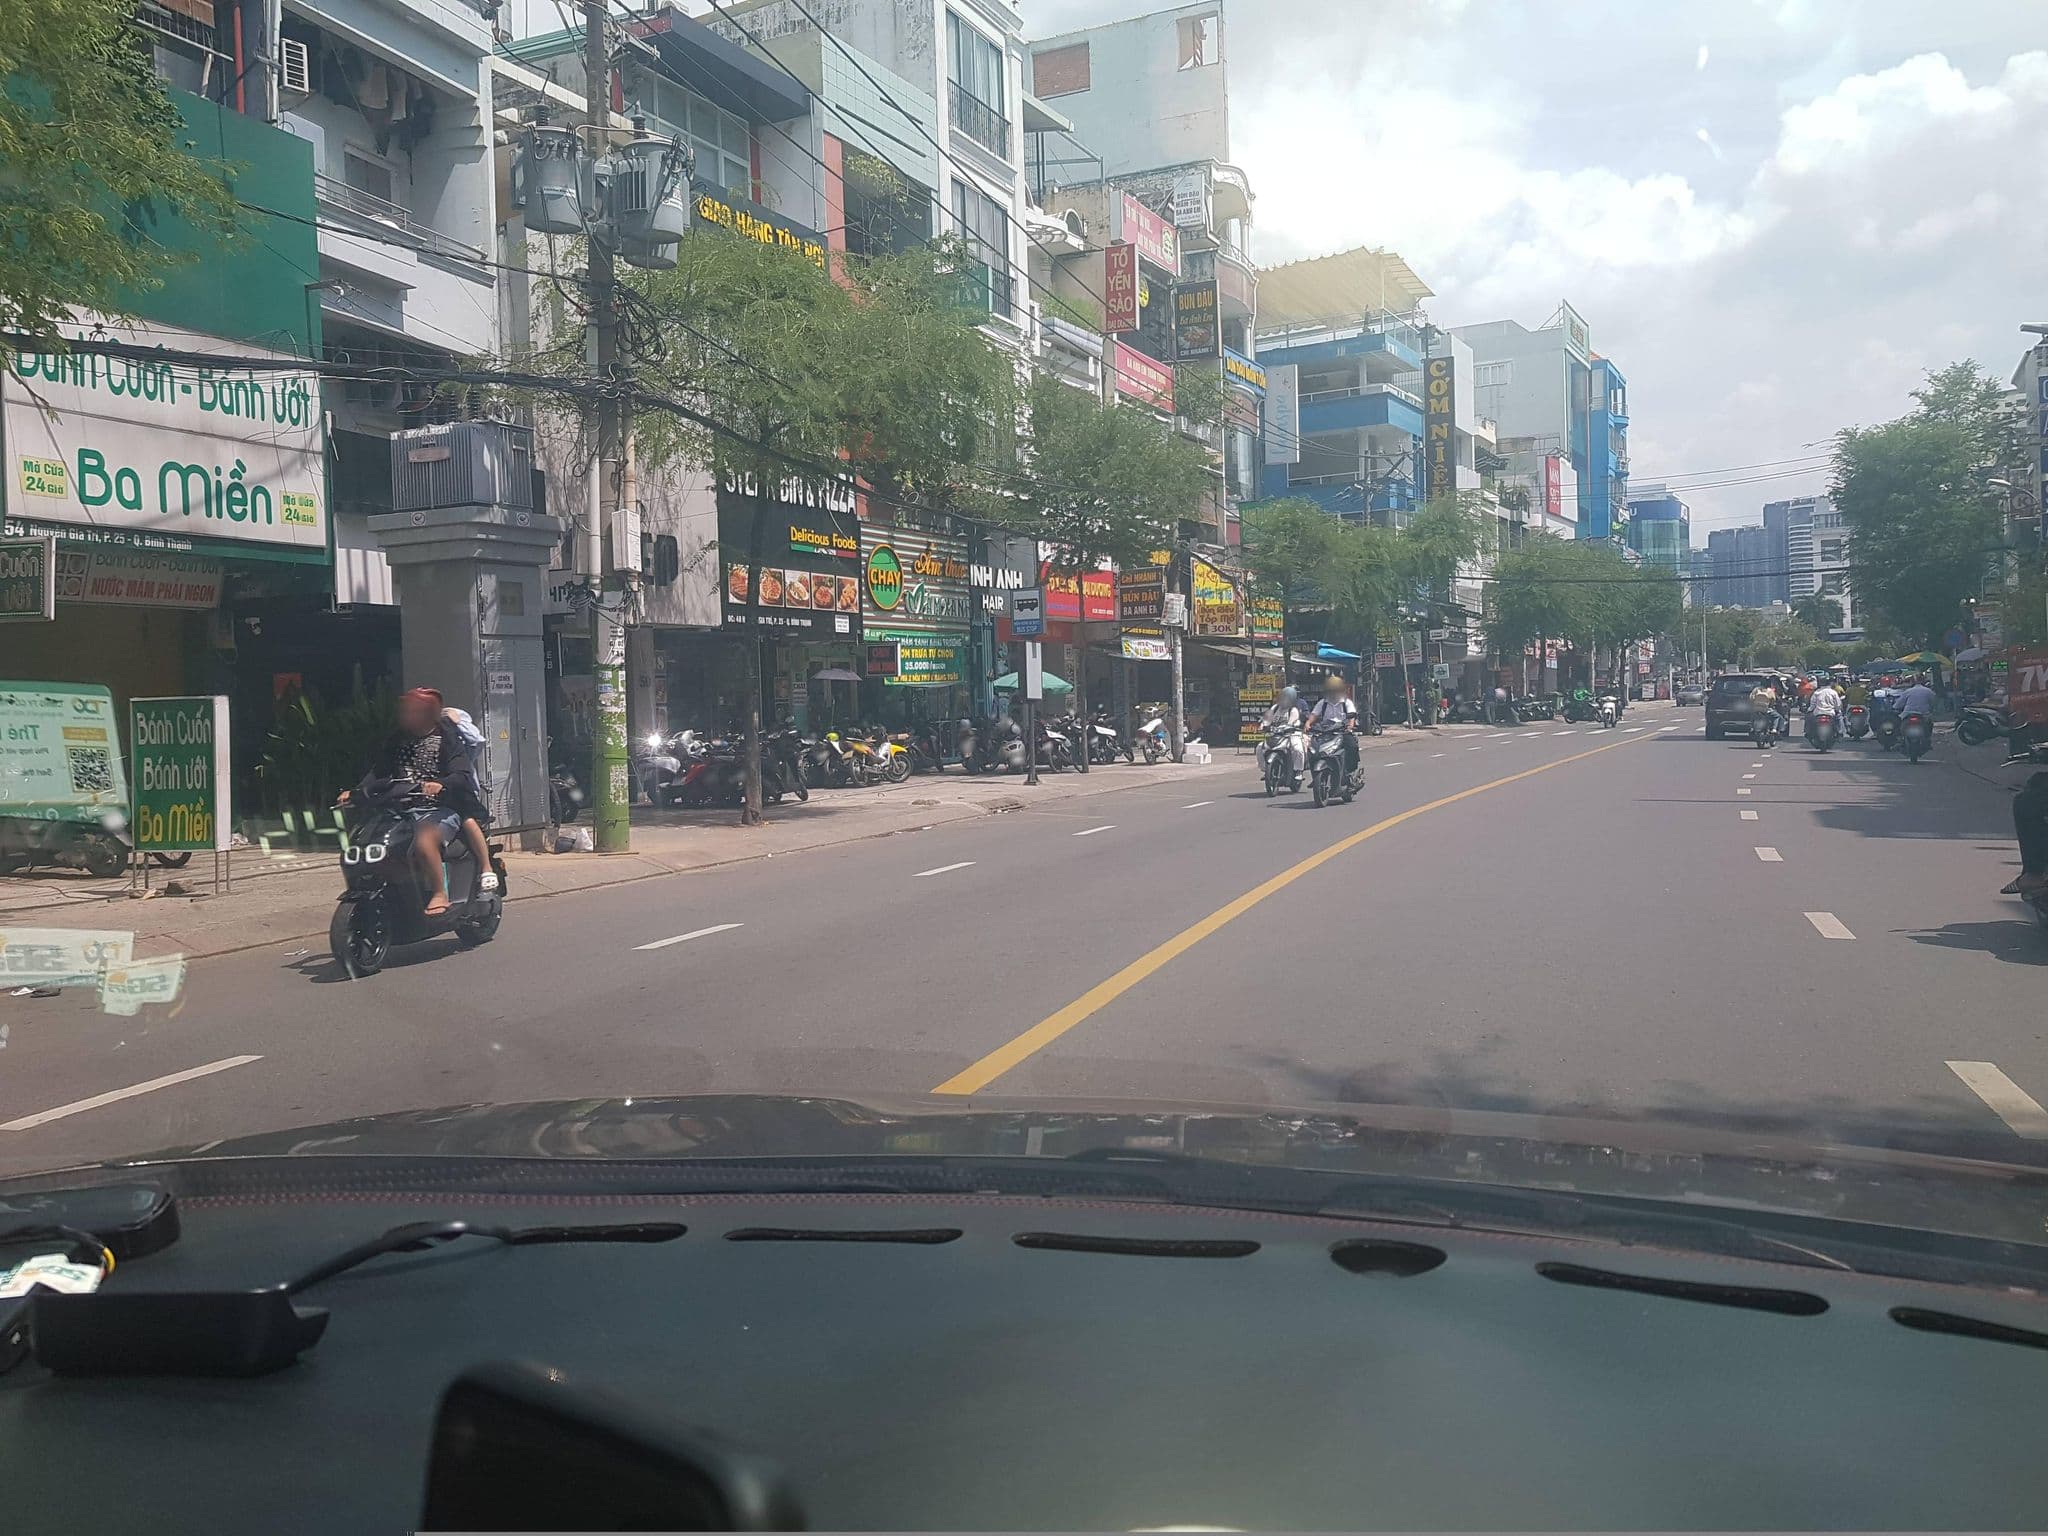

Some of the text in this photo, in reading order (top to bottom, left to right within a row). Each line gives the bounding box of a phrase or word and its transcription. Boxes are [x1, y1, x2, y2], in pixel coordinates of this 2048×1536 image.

[735, 210, 772, 243] HÀNG
[1179, 288, 1213, 311] BÚN ĐẬU
[199, 365, 265, 422] Bánh
[26, 476, 45, 492] 24
[78, 448, 272, 524] Ba Miền
[285, 508, 300, 521] 24
[5, 520, 24, 536] 54
[791, 526, 857, 550] Delicious Foods
[870, 568, 901, 585] CHAY
[996, 569, 1023, 589] ANH
[983, 594, 1003, 610] HAIR
[137, 706, 212, 746] Bánh Cuốn
[143, 757, 180, 790] Bánh
[139, 796, 213, 842] Ba Miền
